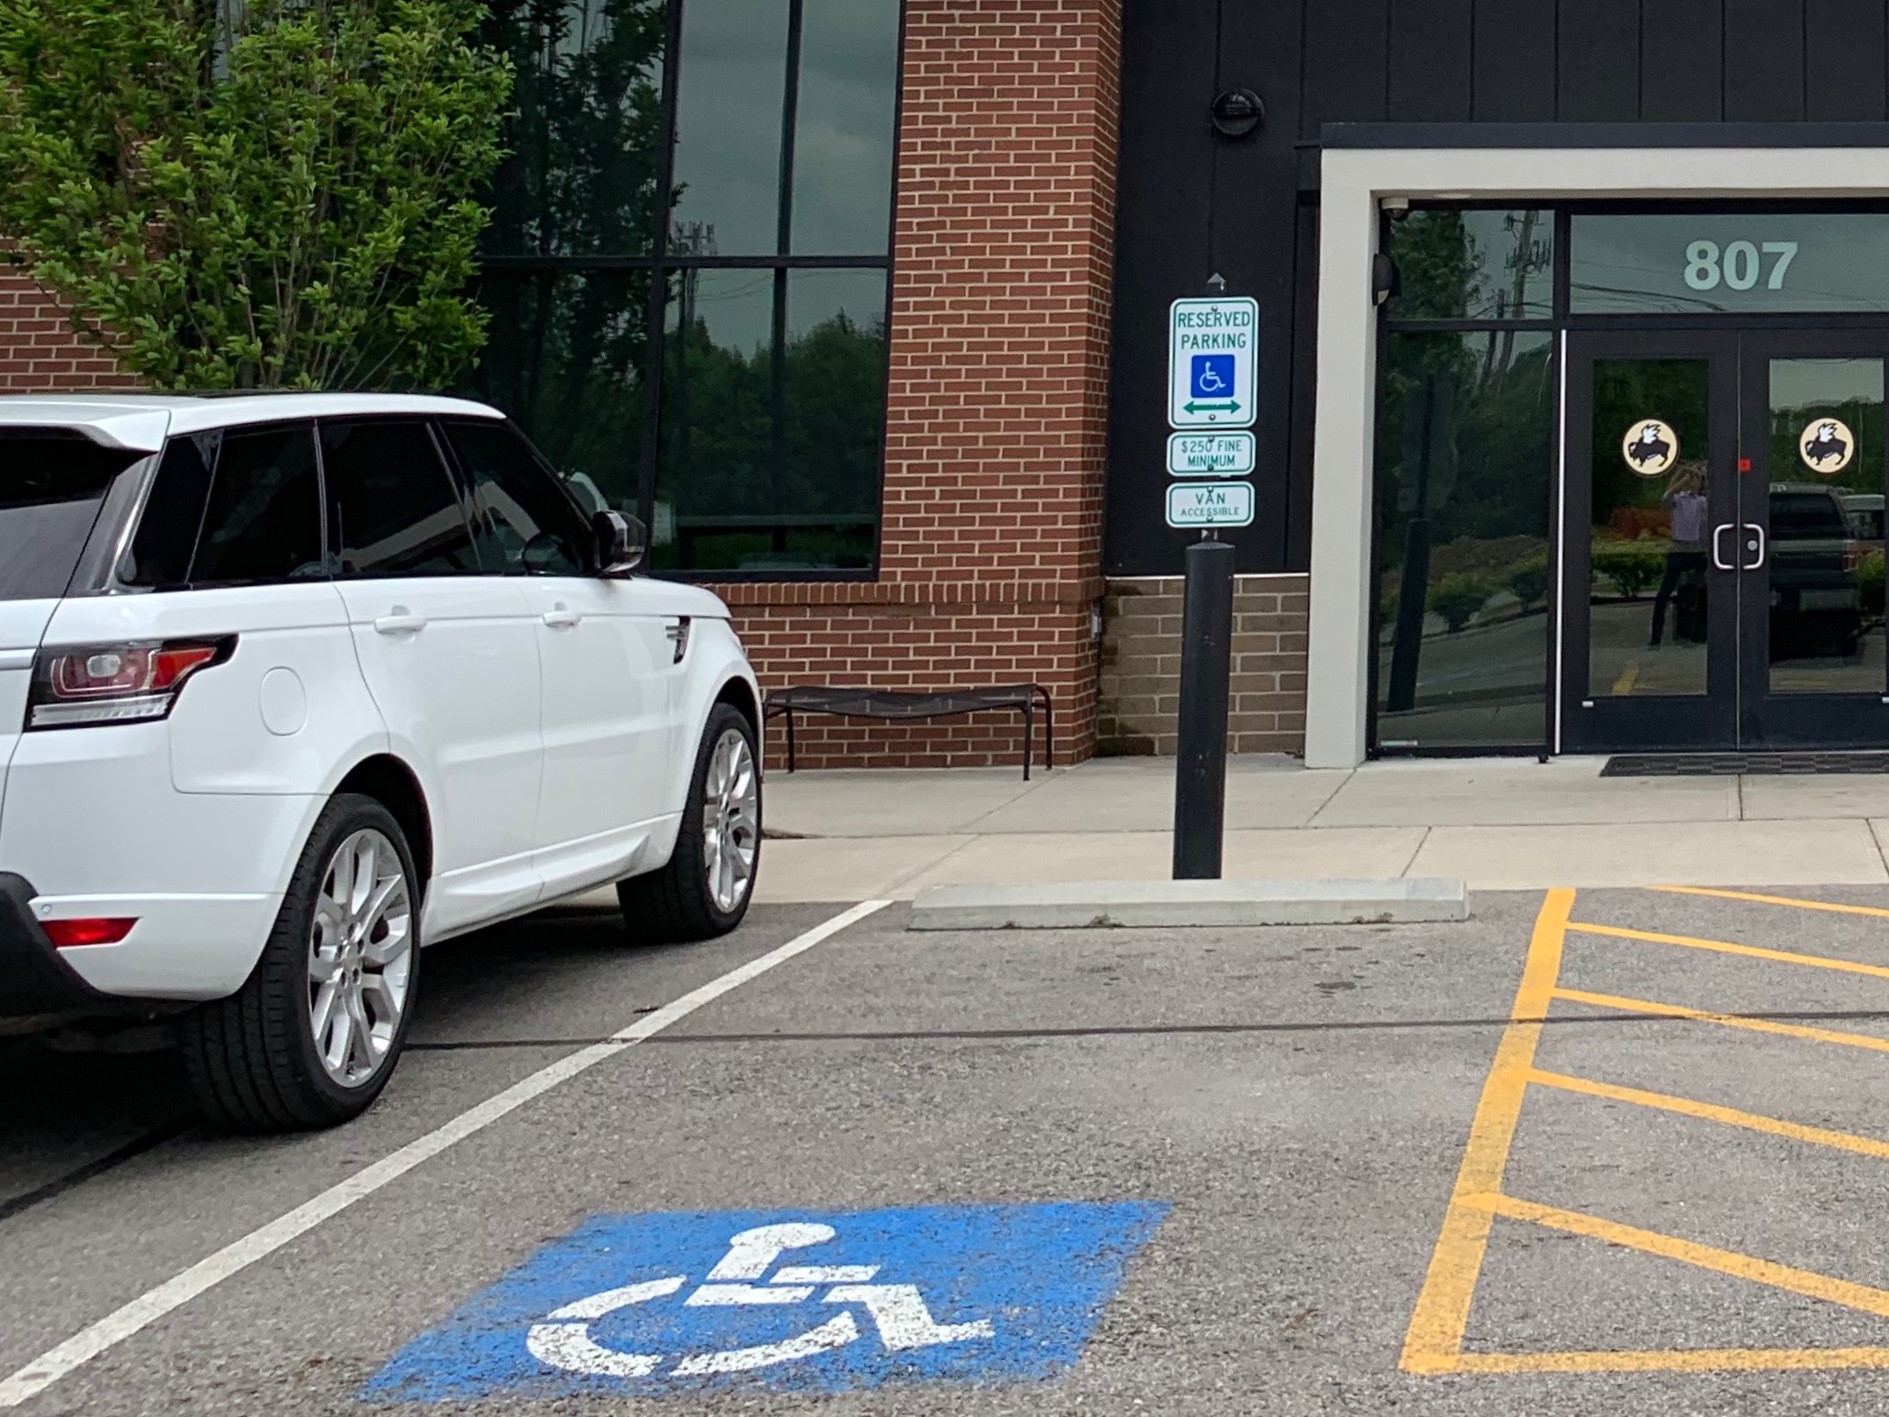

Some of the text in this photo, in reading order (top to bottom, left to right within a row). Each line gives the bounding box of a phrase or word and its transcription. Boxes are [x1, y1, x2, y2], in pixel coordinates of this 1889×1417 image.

[1684, 240, 1798, 290] 807
[1178, 311, 1250, 328] RESERVED
[1181, 333, 1247, 350] PARKING
[1181, 439, 1242, 453] $250 FINE
[1187, 454, 1235, 467] MINIMUM
[1195, 493, 1226, 505] VAN
[1181, 507, 1240, 517] ACCESSIBLE
